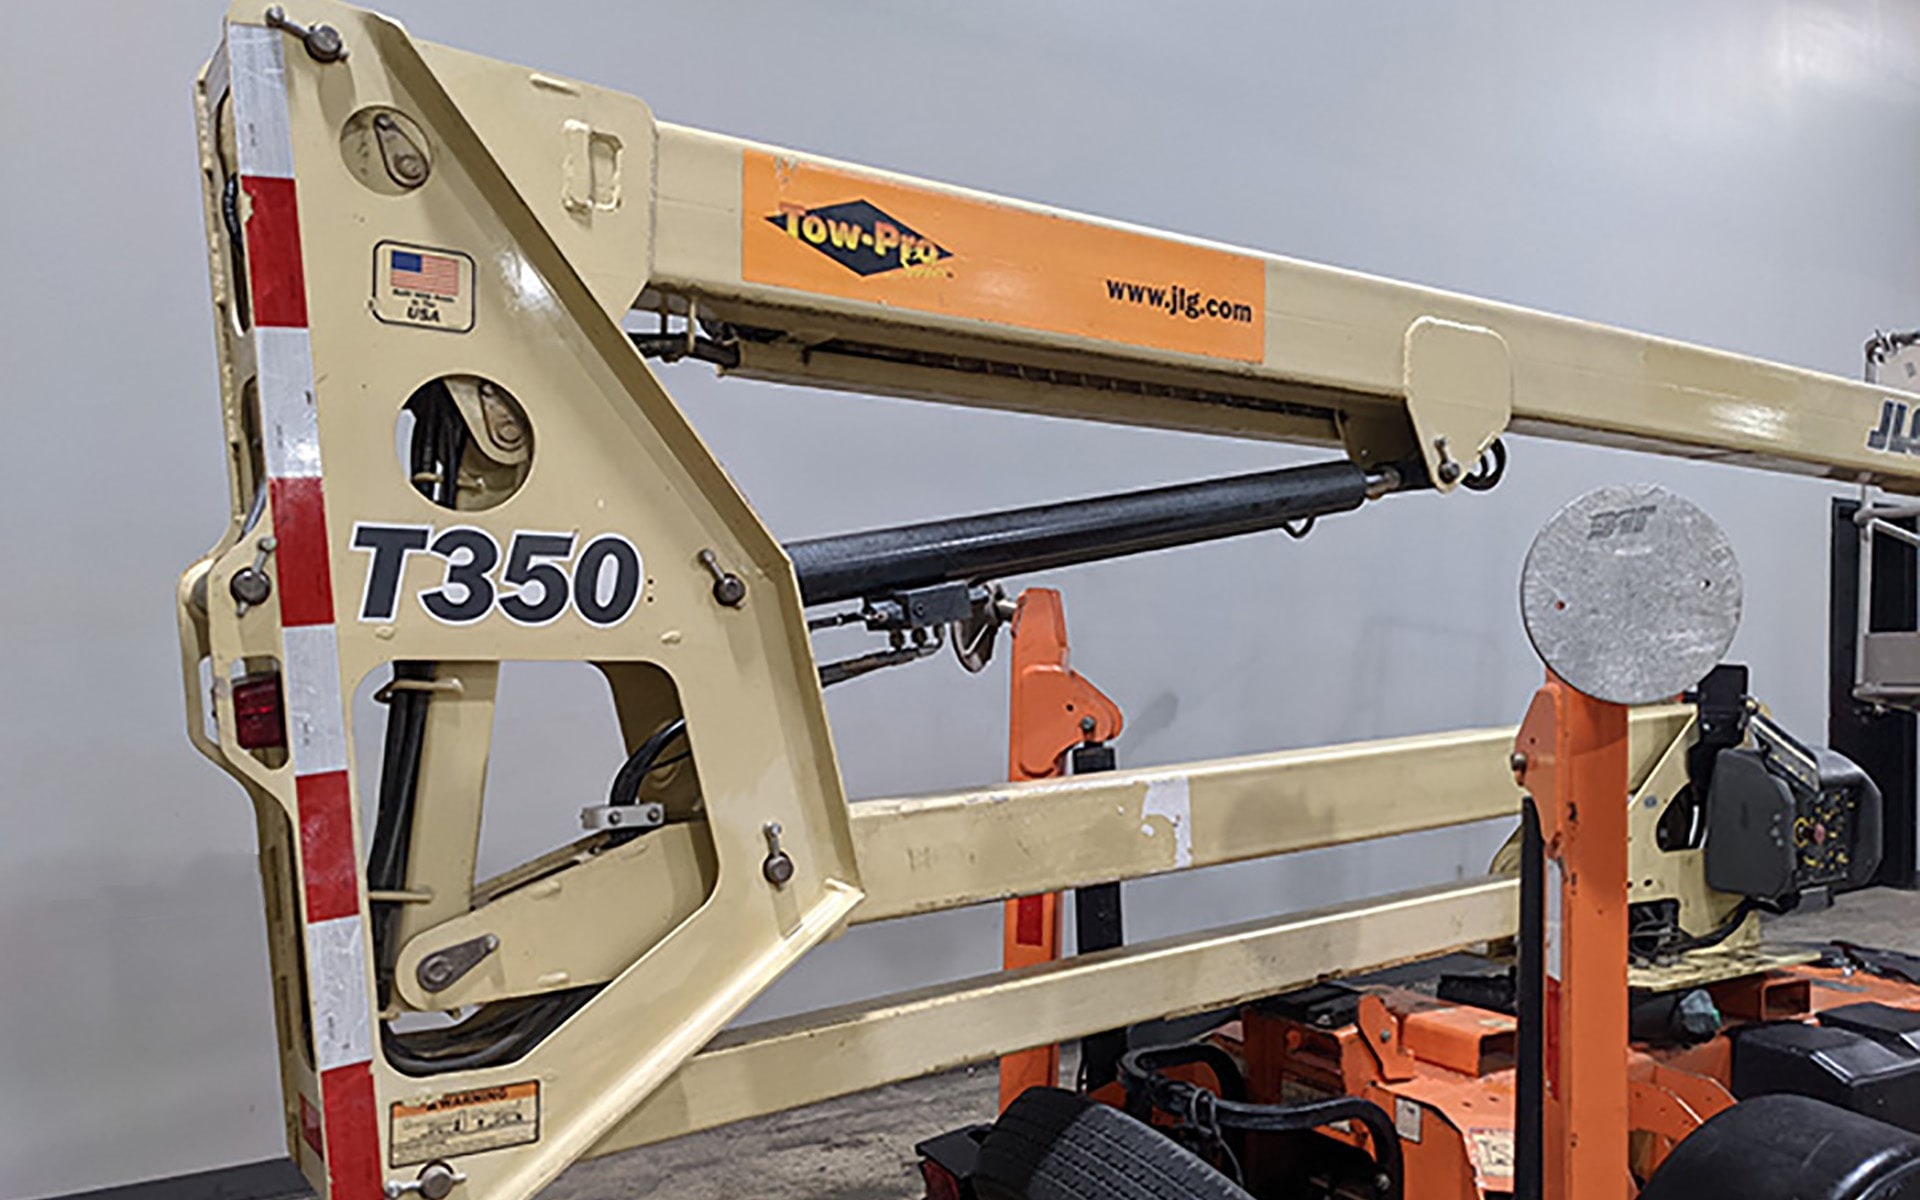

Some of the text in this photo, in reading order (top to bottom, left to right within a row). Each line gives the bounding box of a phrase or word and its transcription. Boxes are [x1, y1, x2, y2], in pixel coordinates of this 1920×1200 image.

[778, 201, 940, 267] Tow-Pro
[407, 306, 440, 322] USA
[1106, 279, 1252, 322] www.jlg.com
[351, 522, 642, 627] T350
